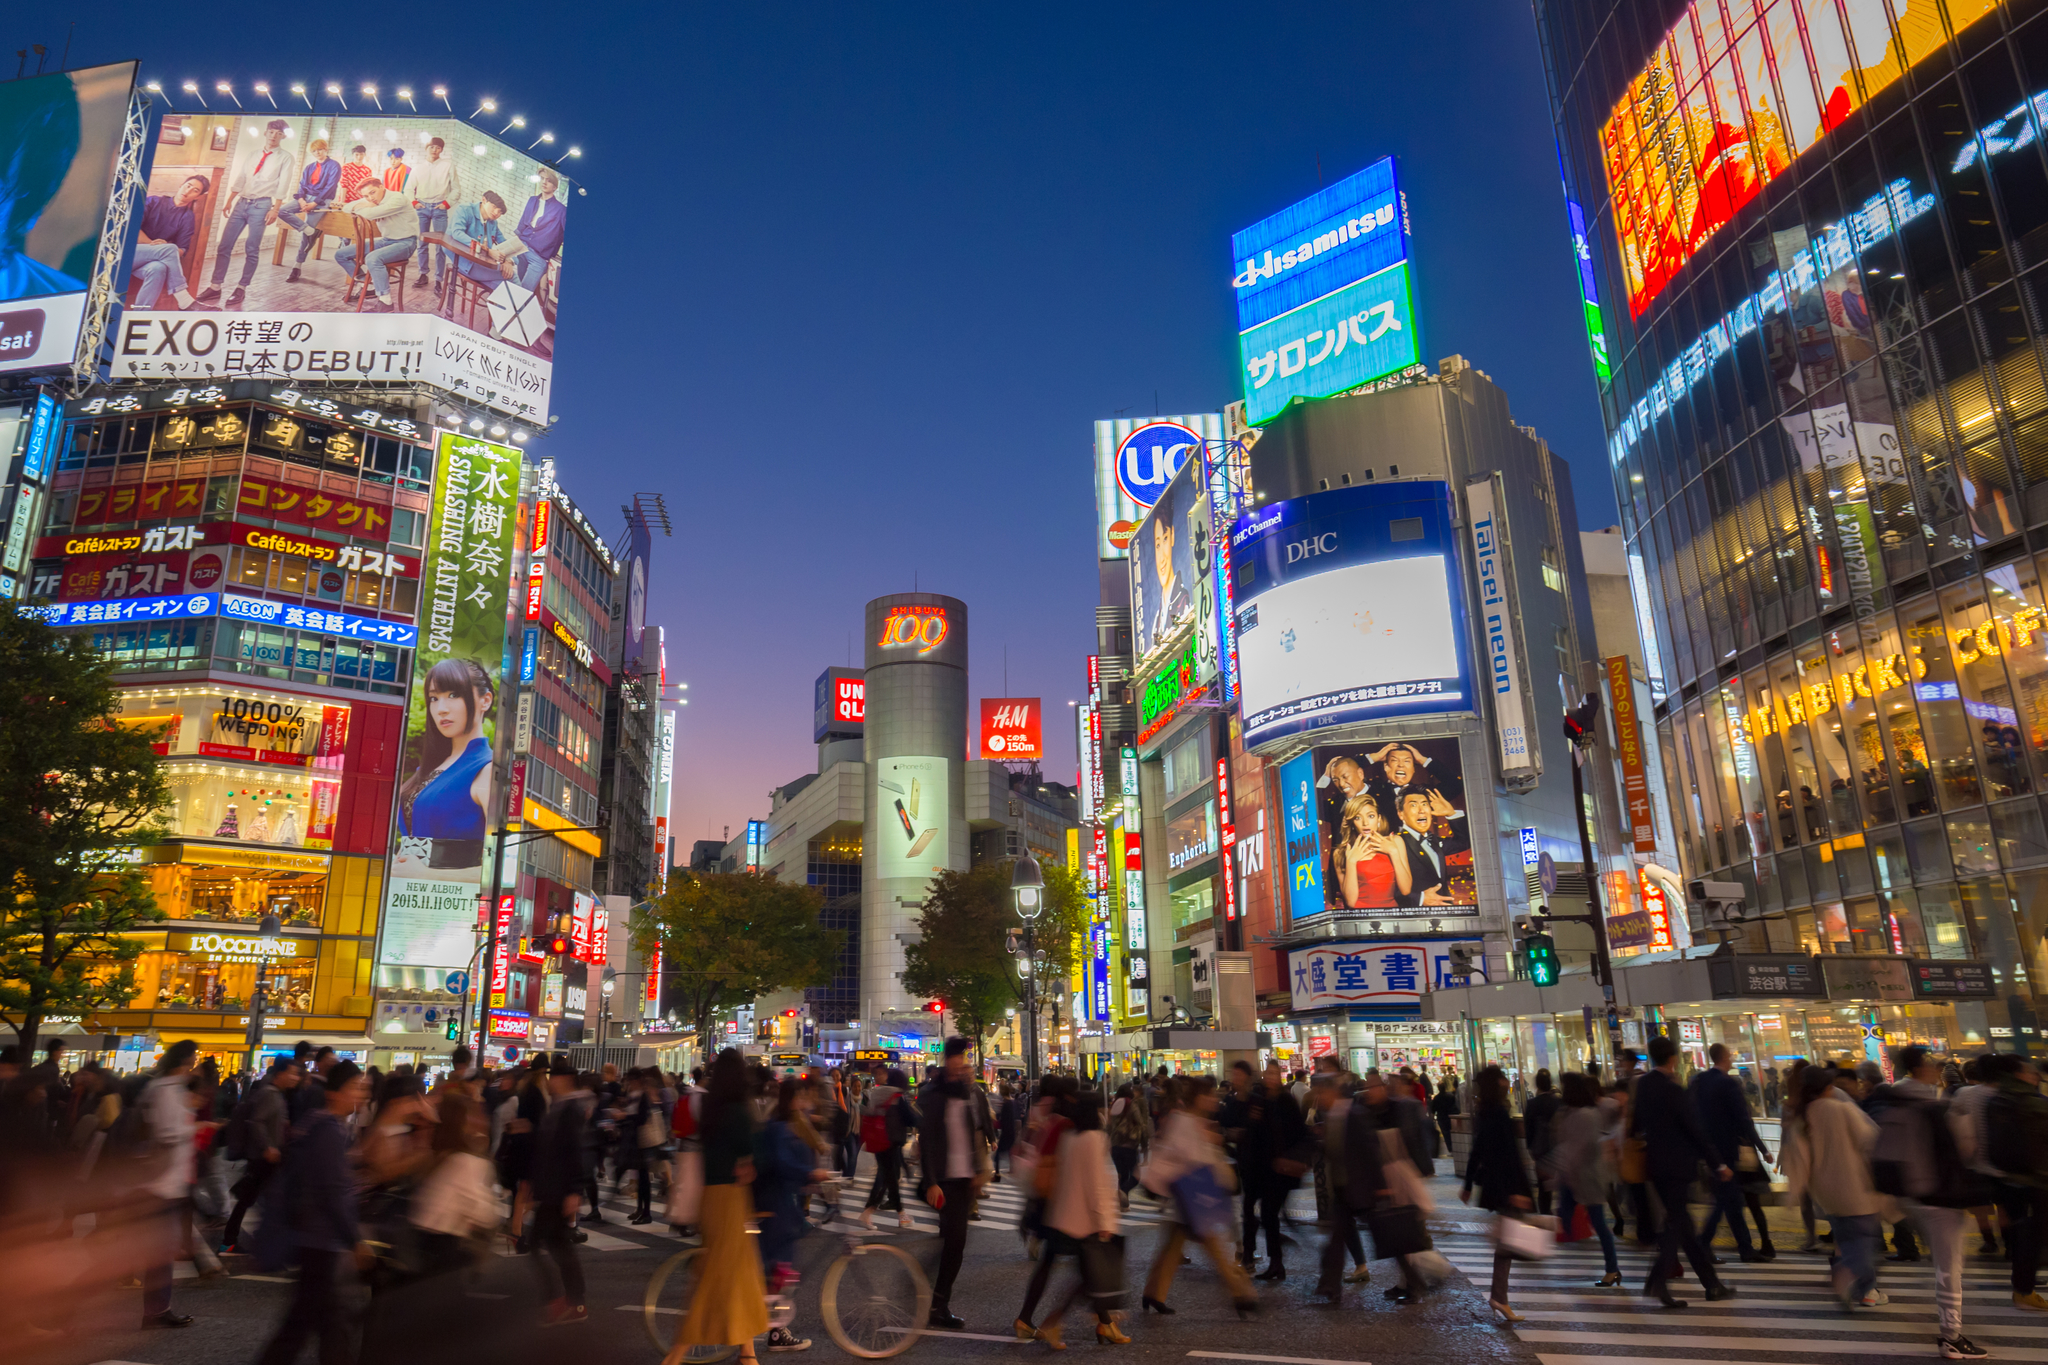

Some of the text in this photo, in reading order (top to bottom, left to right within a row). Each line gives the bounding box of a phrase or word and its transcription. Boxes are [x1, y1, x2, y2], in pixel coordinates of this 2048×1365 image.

[1232, 203, 1395, 288] Hisamitsu
[121, 319, 219, 357] EXO
[224, 319, 313, 345] 待望の
[1246, 299, 1403, 390] サロンパス
[223, 348, 423, 374] 日本DEBUT!!
[450, 330, 537, 369] JAPAN DEBUT SINGLE
[435, 336, 547, 397] LOVE ME RIGHT
[267, 412, 282, 422] 9F
[27, 405, 50, 466] 東急リバブル
[80, 481, 201, 518] プライス
[239, 481, 387, 533] コンタクト
[7, 503, 29, 560] 献血ルーム
[65, 525, 205, 555] Caféレストラン ガスト
[465, 463, 511, 611] 水樹奈々
[1232, 511, 1282, 548] DHC Channel
[246, 530, 406, 577] Caféレストラン ガスト
[428, 454, 473, 654] SMASHING ANTHEMS
[1286, 531, 1339, 565] DHC
[33, 574, 63, 596] 7F
[68, 570, 101, 587] Café
[101, 562, 179, 599] ガスト
[193, 568, 219, 579] ガスト
[70, 599, 184, 623] 英会話イーオン
[191, 597, 208, 612] 6F
[227, 600, 276, 620] AEON
[528, 586, 541, 615] ガスト
[891, 606, 947, 616] SHIBUYA
[1474, 511, 1511, 695] Taisei neon
[284, 607, 414, 643] 英会話イーオン
[878, 614, 949, 654] 109
[1954, 603, 2048, 665] COF
[575, 639, 594, 669] ガスト
[839, 683, 865, 700] UN
[221, 696, 305, 728] 1000%
[516, 697, 529, 748] 渋谷駅前ビル
[839, 700, 865, 719] QL
[992, 704, 1029, 729] H&M
[1317, 714, 1338, 726] DHC
[1006, 733, 1028, 742] この先
[1006, 741, 1035, 752] 150m
[1502, 726, 1522, 737] (03)
[1503, 737, 1524, 748] 3719
[513, 760, 526, 768] 5F
[1504, 745, 1526, 756] 2468
[1610, 661, 1654, 844] クスリのことなら 三千里
[899, 763, 919, 771] iPhone
[1168, 838, 1207, 869] Euphoria
[1287, 832, 1319, 865] DMM
[405, 881, 463, 895] NEW ALBUM
[1295, 860, 1316, 891] FX
[1096, 929, 1105, 960] MIZUHO
[1096, 981, 1106, 1015] みずほ銀行
[1748, 976, 1789, 991] 渋谷駅
